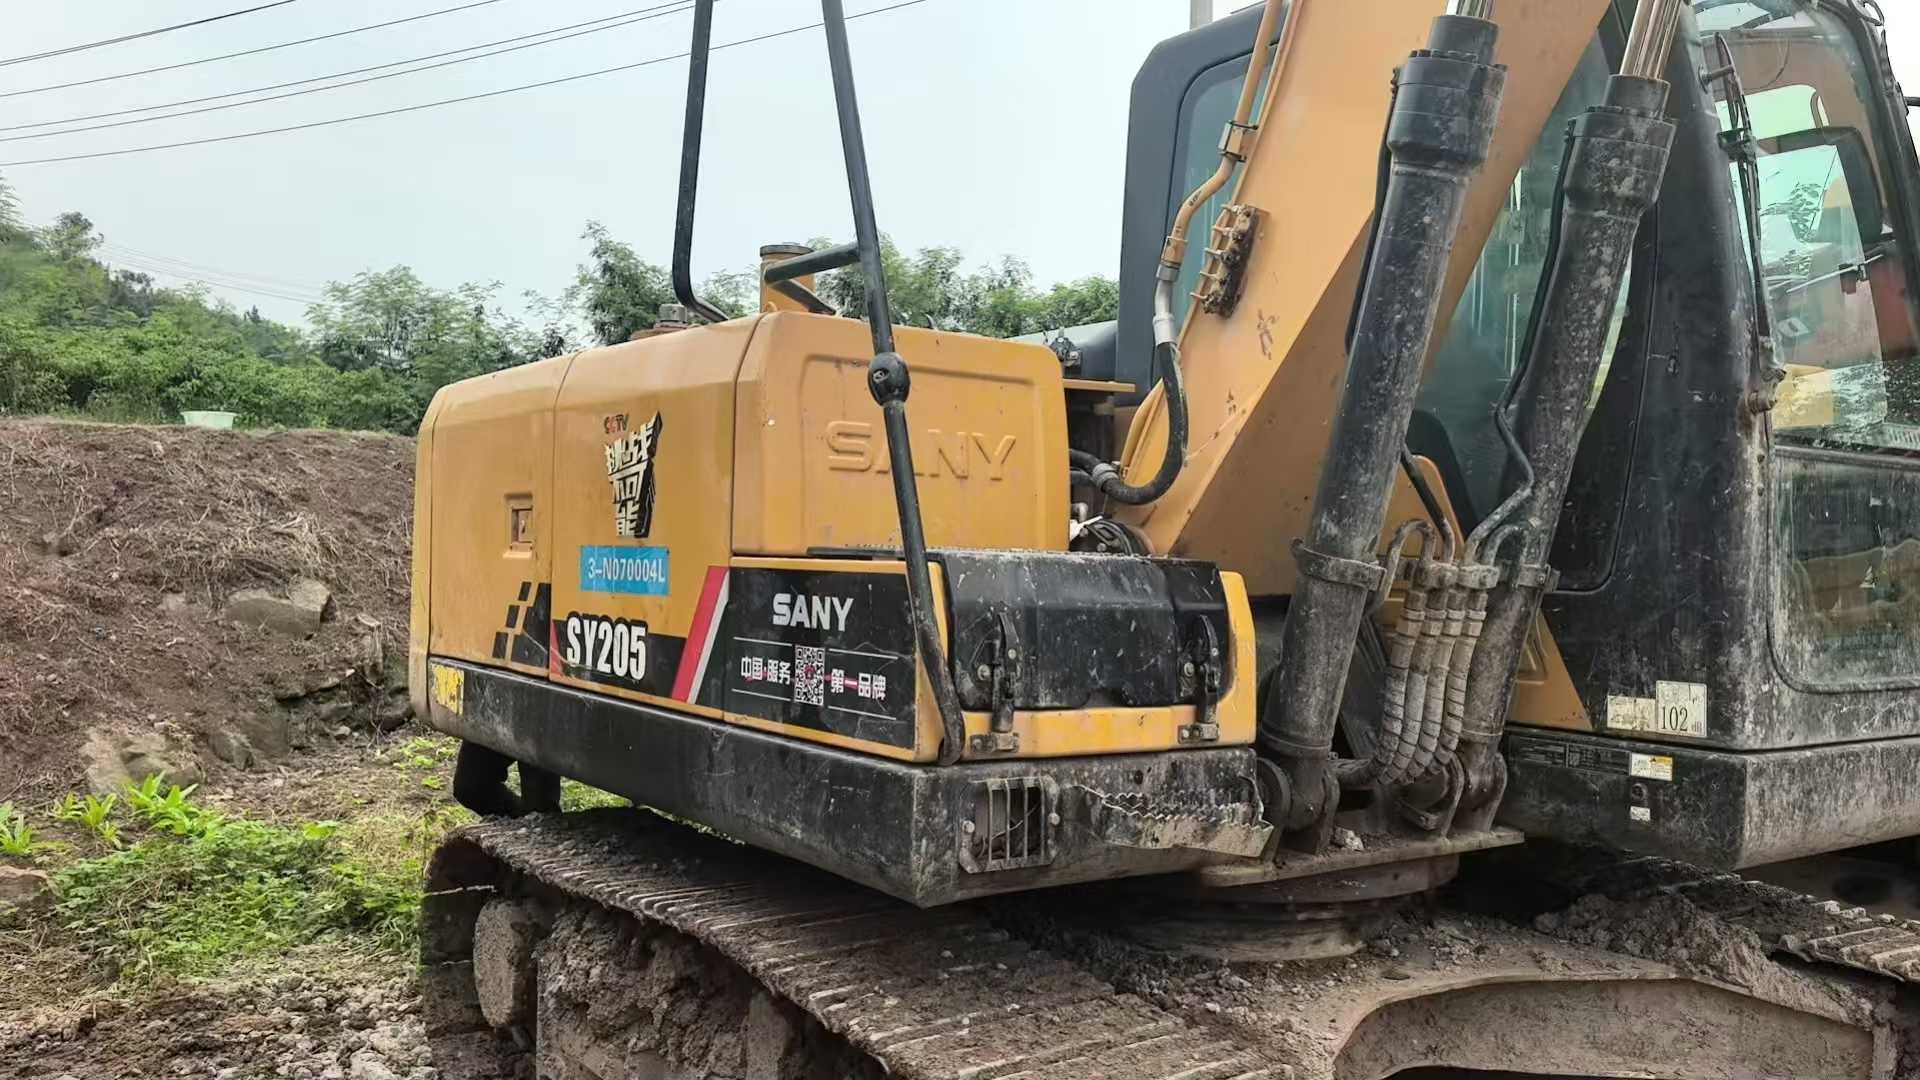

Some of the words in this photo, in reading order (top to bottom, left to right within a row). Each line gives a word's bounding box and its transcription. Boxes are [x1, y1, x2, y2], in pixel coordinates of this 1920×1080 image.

[603, 413, 629, 433] CCTV
[588, 556, 665, 583] 3-N070004L
[772, 593, 854, 631] SANY
[566, 616, 646, 680] SY205
[831, 668, 886, 700] 第一品牌
[1660, 705, 1688, 732] 102
